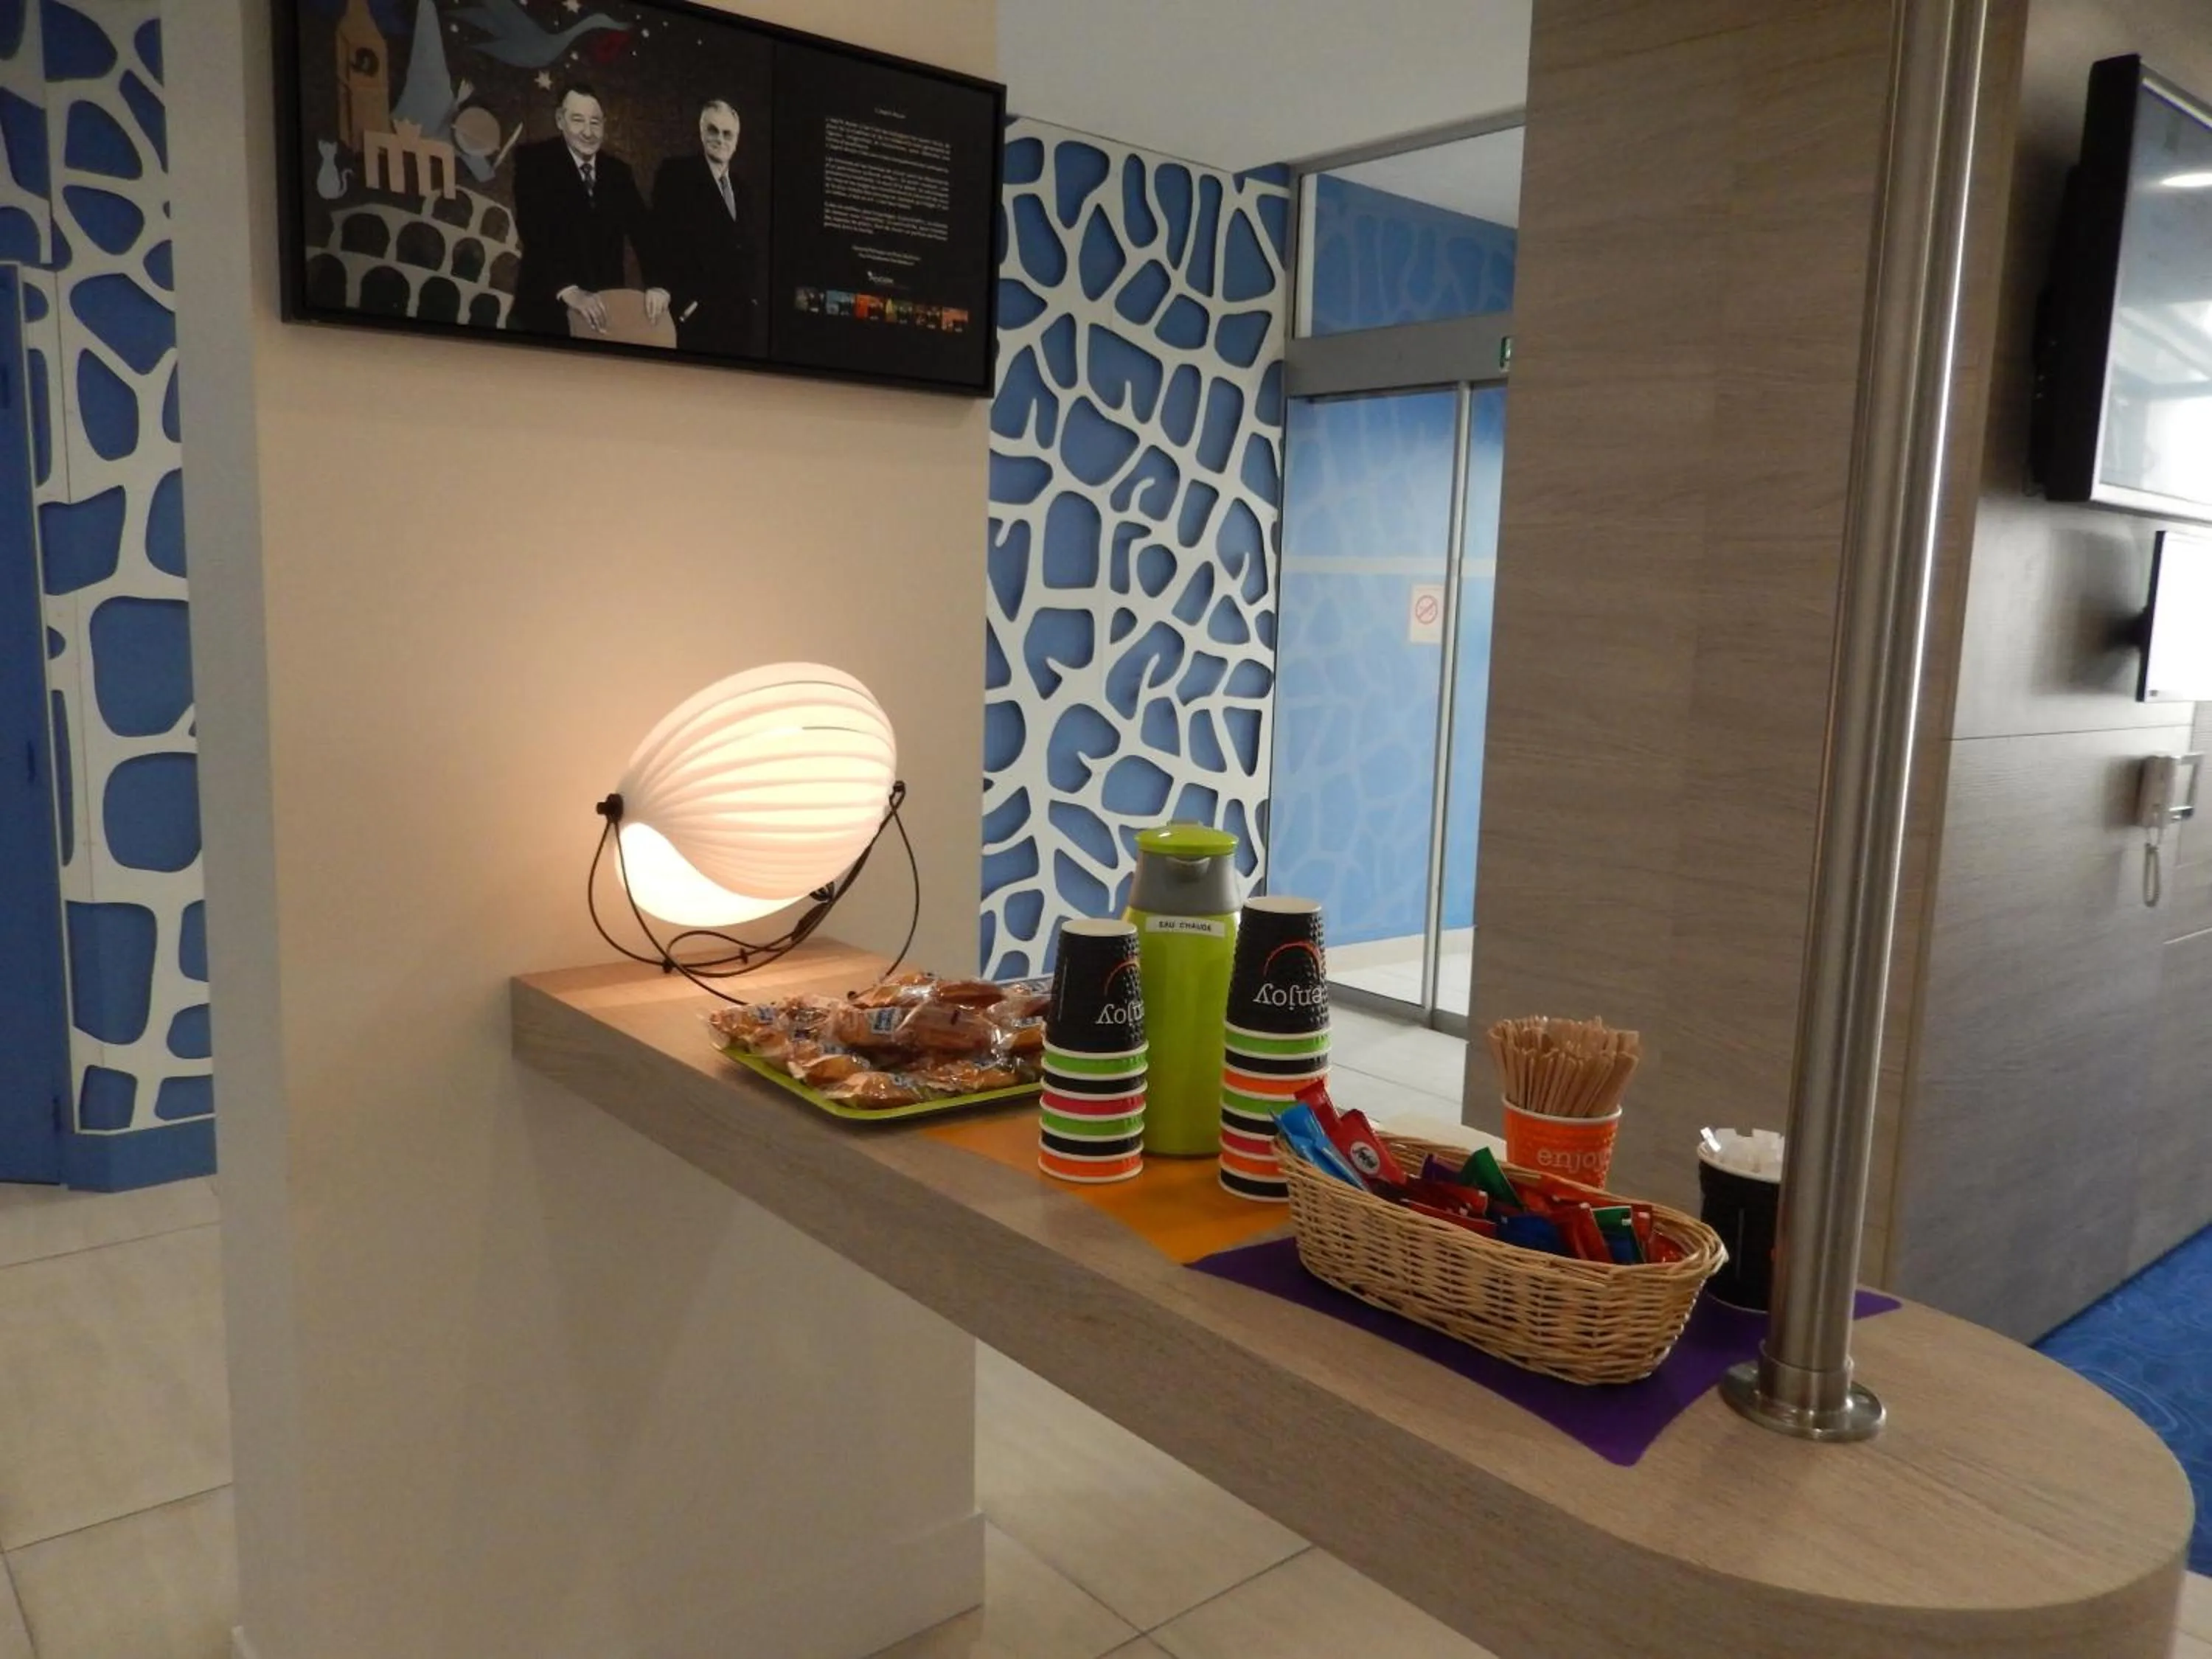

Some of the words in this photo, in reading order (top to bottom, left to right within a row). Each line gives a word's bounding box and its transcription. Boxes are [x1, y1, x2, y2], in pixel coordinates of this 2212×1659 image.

[1158, 920, 1175, 929] EAU
[1179, 922, 1211, 932] CHAUDE
[1252, 983, 1322, 1010] enjoy
